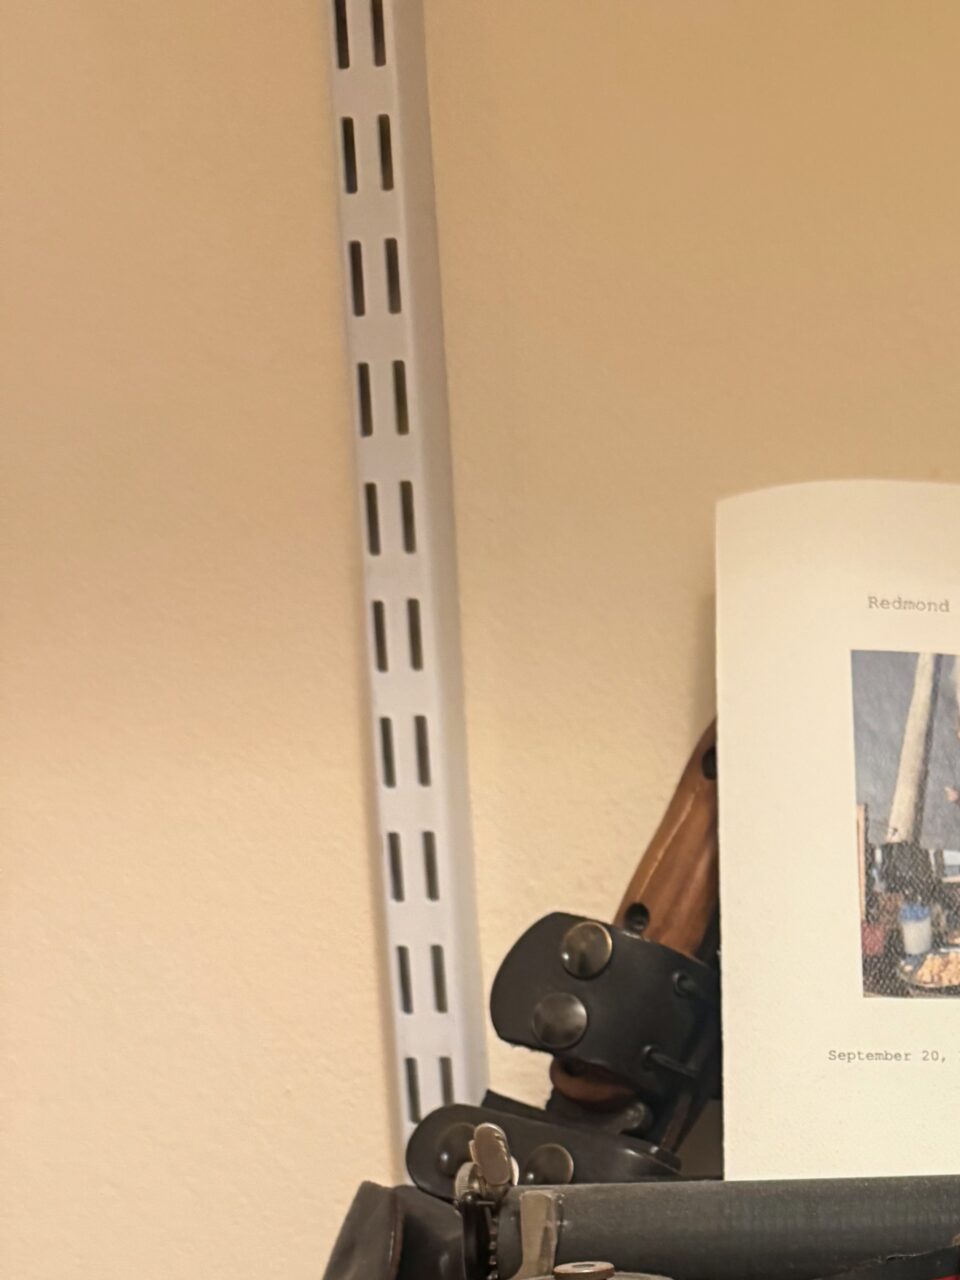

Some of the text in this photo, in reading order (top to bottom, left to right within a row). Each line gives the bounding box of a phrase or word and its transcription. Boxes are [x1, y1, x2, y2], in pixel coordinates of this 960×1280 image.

[867, 596, 950, 613] Redmond
[828, 1050, 912, 1063] September
[921, 1050, 946, 1063] 20,
